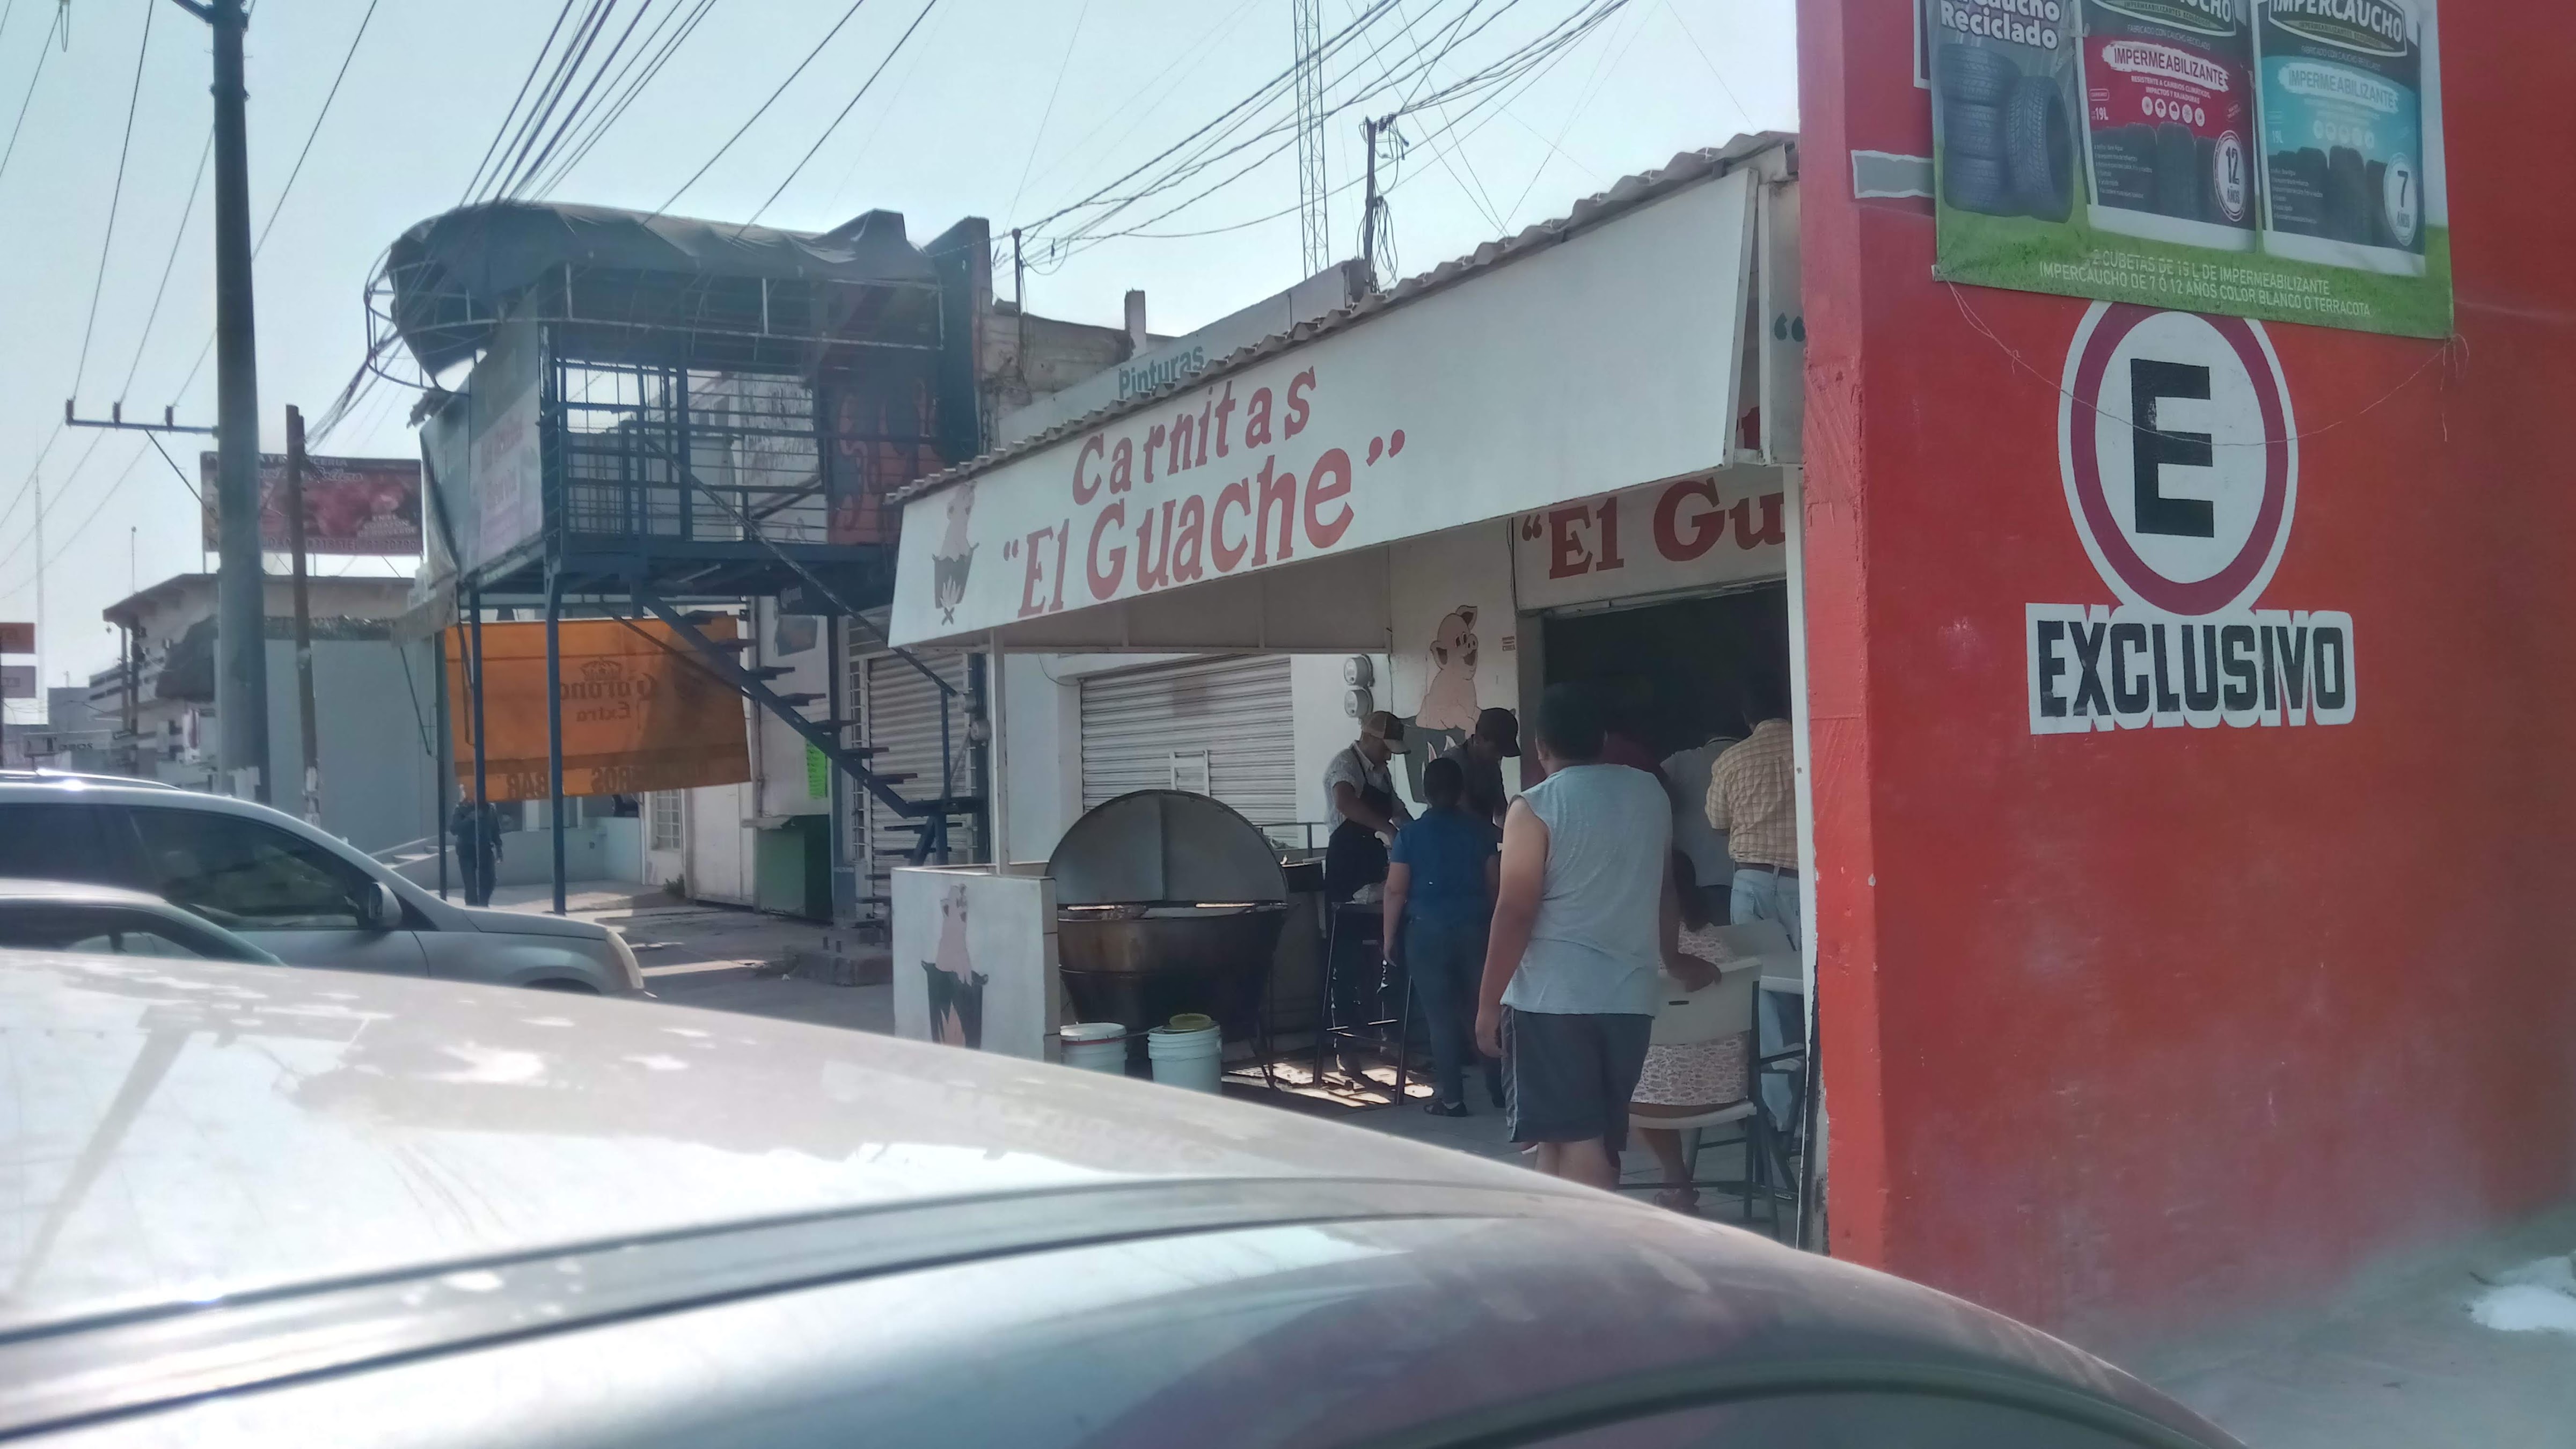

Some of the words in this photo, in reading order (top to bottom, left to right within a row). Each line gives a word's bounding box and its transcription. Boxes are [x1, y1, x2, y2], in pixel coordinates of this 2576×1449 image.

[1941, 0, 2058, 49] Reciclado
[1971, 0, 2060, 21] aucho
[2114, 47, 2223, 86] IMPERMEABILIZANTE
[2131, 75, 2158, 86] RESISTENTE
[2163, 80, 2185, 91] CAMBIOS
[2095, 107, 2109, 120] 19L
[2146, 86, 2169, 97] IMPACTOS
[2174, 91, 2200, 104] RAJADURAS
[2226, 147, 2240, 185] 12
[2397, 170, 2408, 208] 7
[2040, 260, 2127, 287] IMPERCAUCHO
[2131, 274, 2147, 290] DE
[2149, 275, 2155, 291] 7
[2159, 273, 2168, 292] Ó
[2171, 278, 2184, 295] 12
[2186, 277, 2217, 299] AÑOS
[2220, 284, 2257, 303] COLOR
[2259, 290, 2301, 309] BLANCO
[2304, 296, 2311, 310] O
[2314, 296, 2372, 317] TERRACOTA
[2103, 250, 2155, 272] CUBETAS
[2159, 258, 2174, 275] DE
[2192, 262, 2200, 278] L
[2202, 264, 2217, 280] DE
[2220, 266, 2330, 295] IMPERMEABILIZANTE
[1118, 346, 1204, 400] Pinturas
[1073, 366, 1316, 505] Carnitas
[2130, 358, 2214, 538] E
[2038, 619, 2346, 718] EXCLUSIVO
